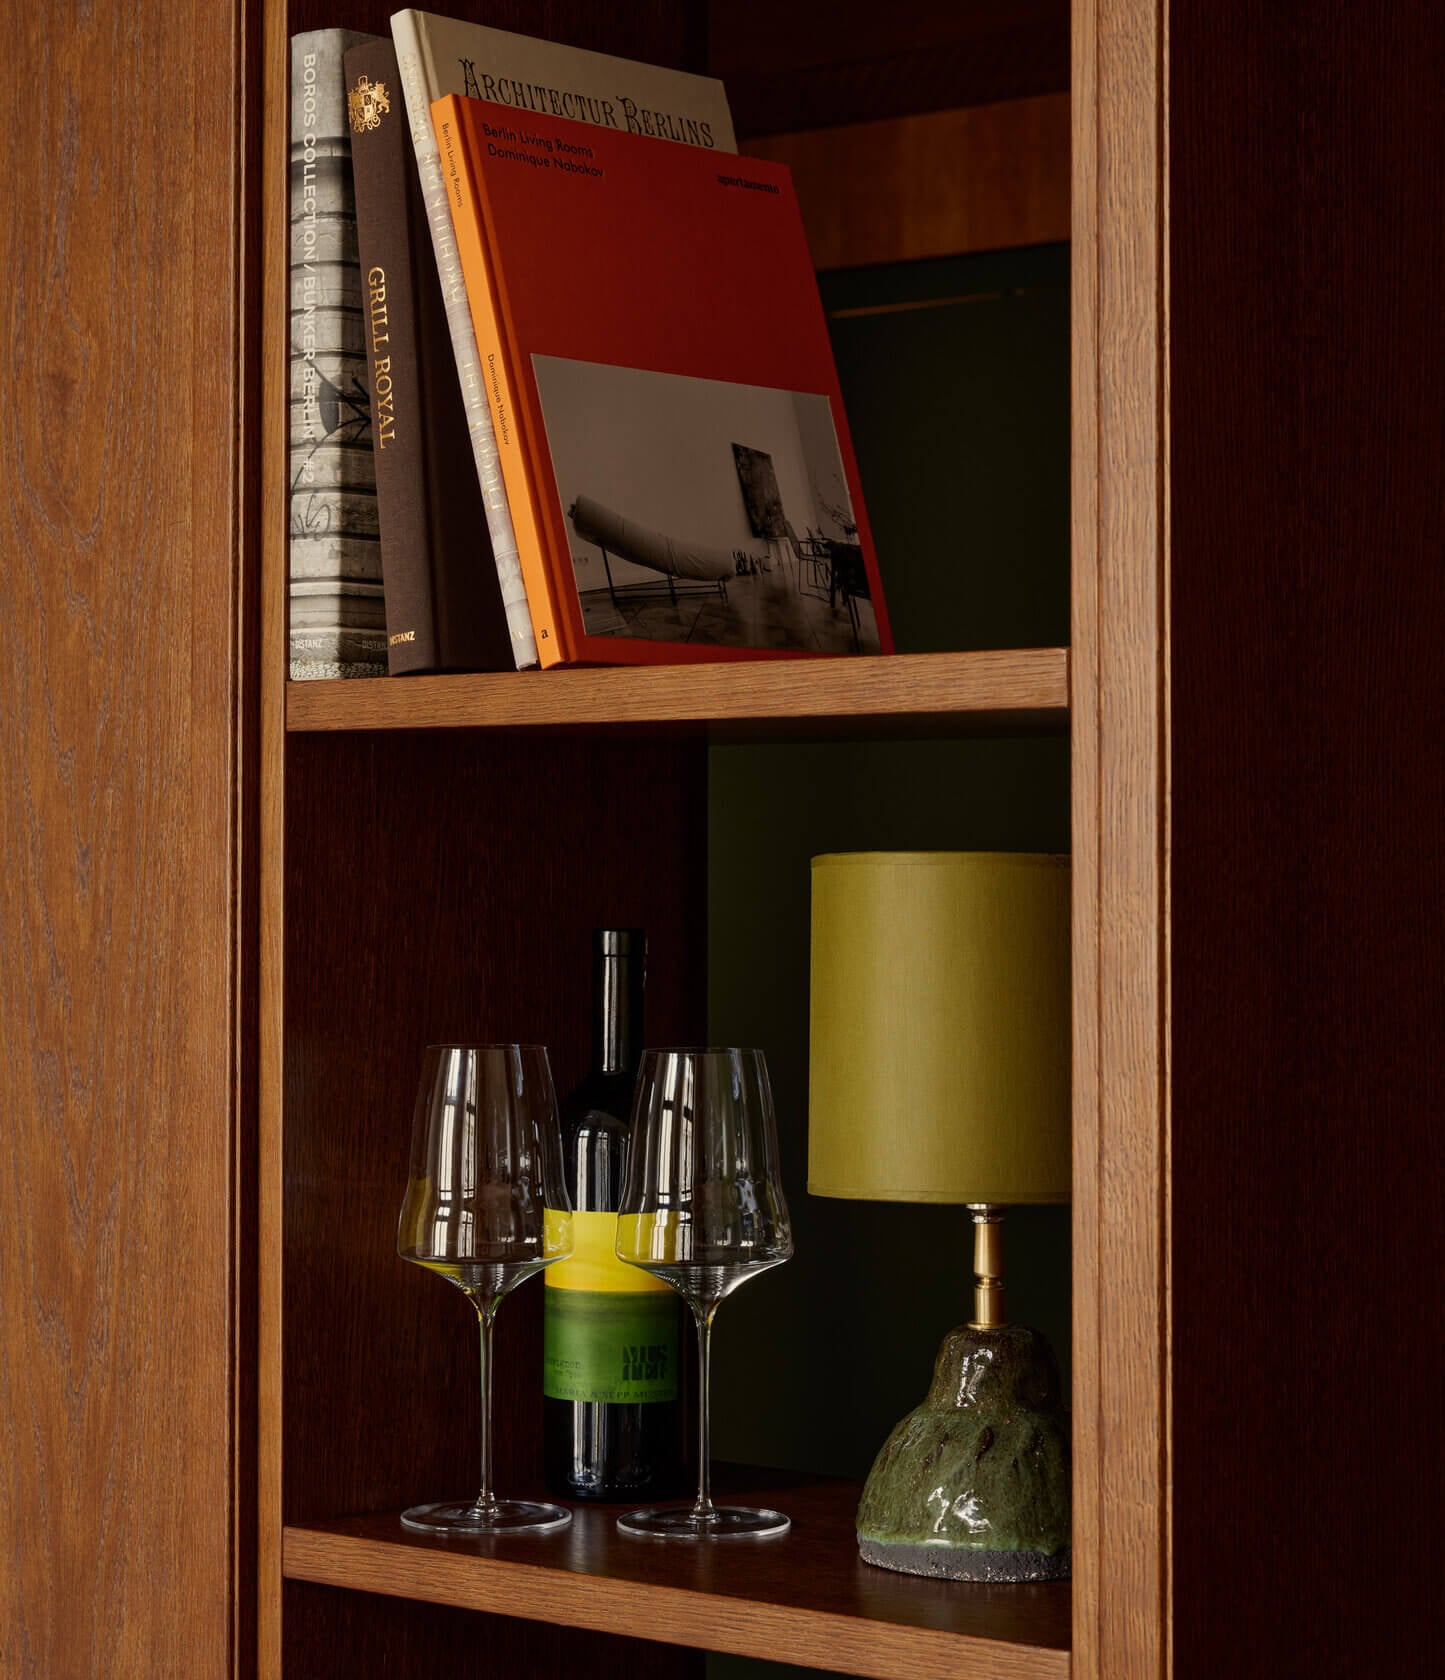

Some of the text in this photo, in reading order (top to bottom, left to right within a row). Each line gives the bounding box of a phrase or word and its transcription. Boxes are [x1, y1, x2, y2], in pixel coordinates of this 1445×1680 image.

[303, 53, 316, 127] BOROS
[457, 57, 714, 148] ARCHITECTUR BERLINS
[441, 123, 464, 208] Berlin Living Rooms
[482, 122, 593, 159] Berlin Living Rooms
[487, 143, 604, 178] Dominique Nabokov
[303, 133, 317, 261] COLLECTION
[716, 174, 781, 195] apartamento
[303, 276, 316, 362] BUNKER
[367, 266, 396, 450] GRILL ROYAL
[303, 367, 316, 440] BERLIN
[487, 354, 510, 445] Dominique Nabokov
[302, 456, 315, 484] #2
[540, 628, 549, 640] a
